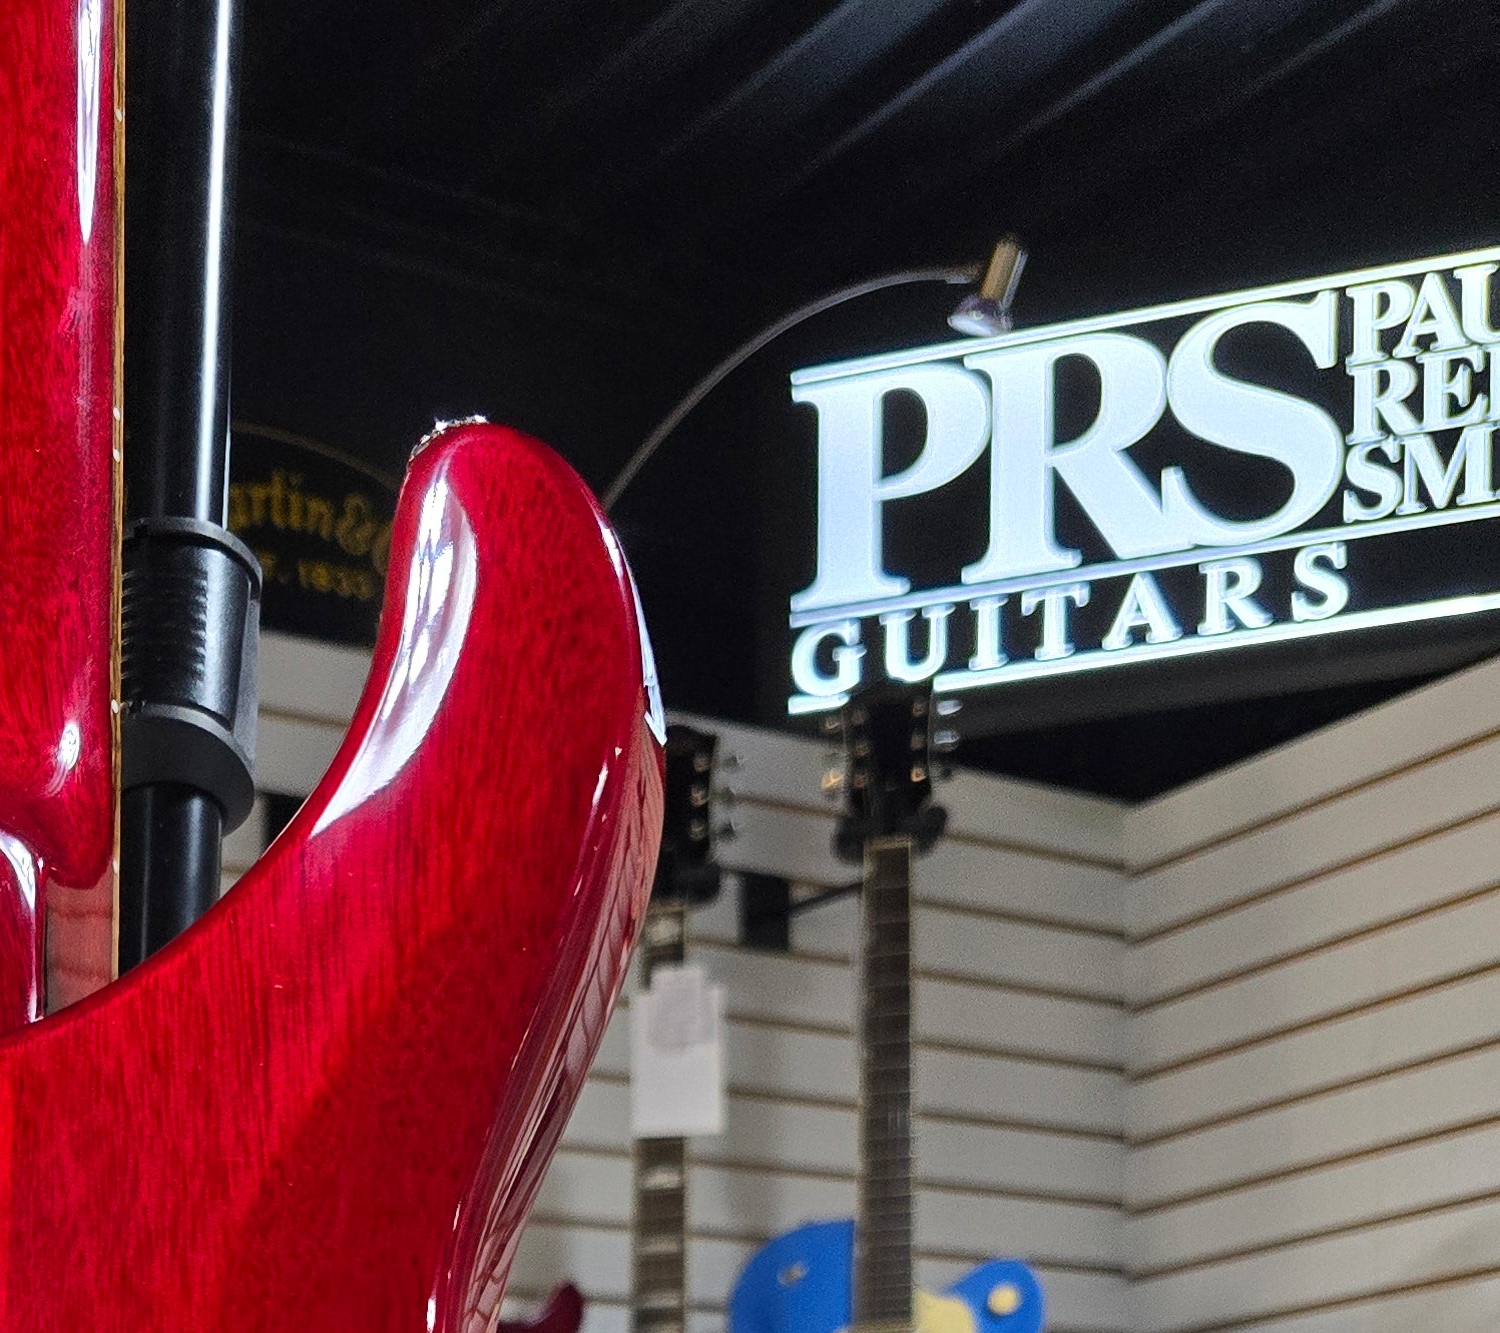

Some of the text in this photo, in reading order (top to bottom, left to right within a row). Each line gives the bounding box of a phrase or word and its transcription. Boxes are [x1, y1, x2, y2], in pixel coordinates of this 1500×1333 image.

[790, 290, 1346, 604] PRS
[1345, 343, 1500, 446] RE
[790, 541, 1352, 700] GUITARS
